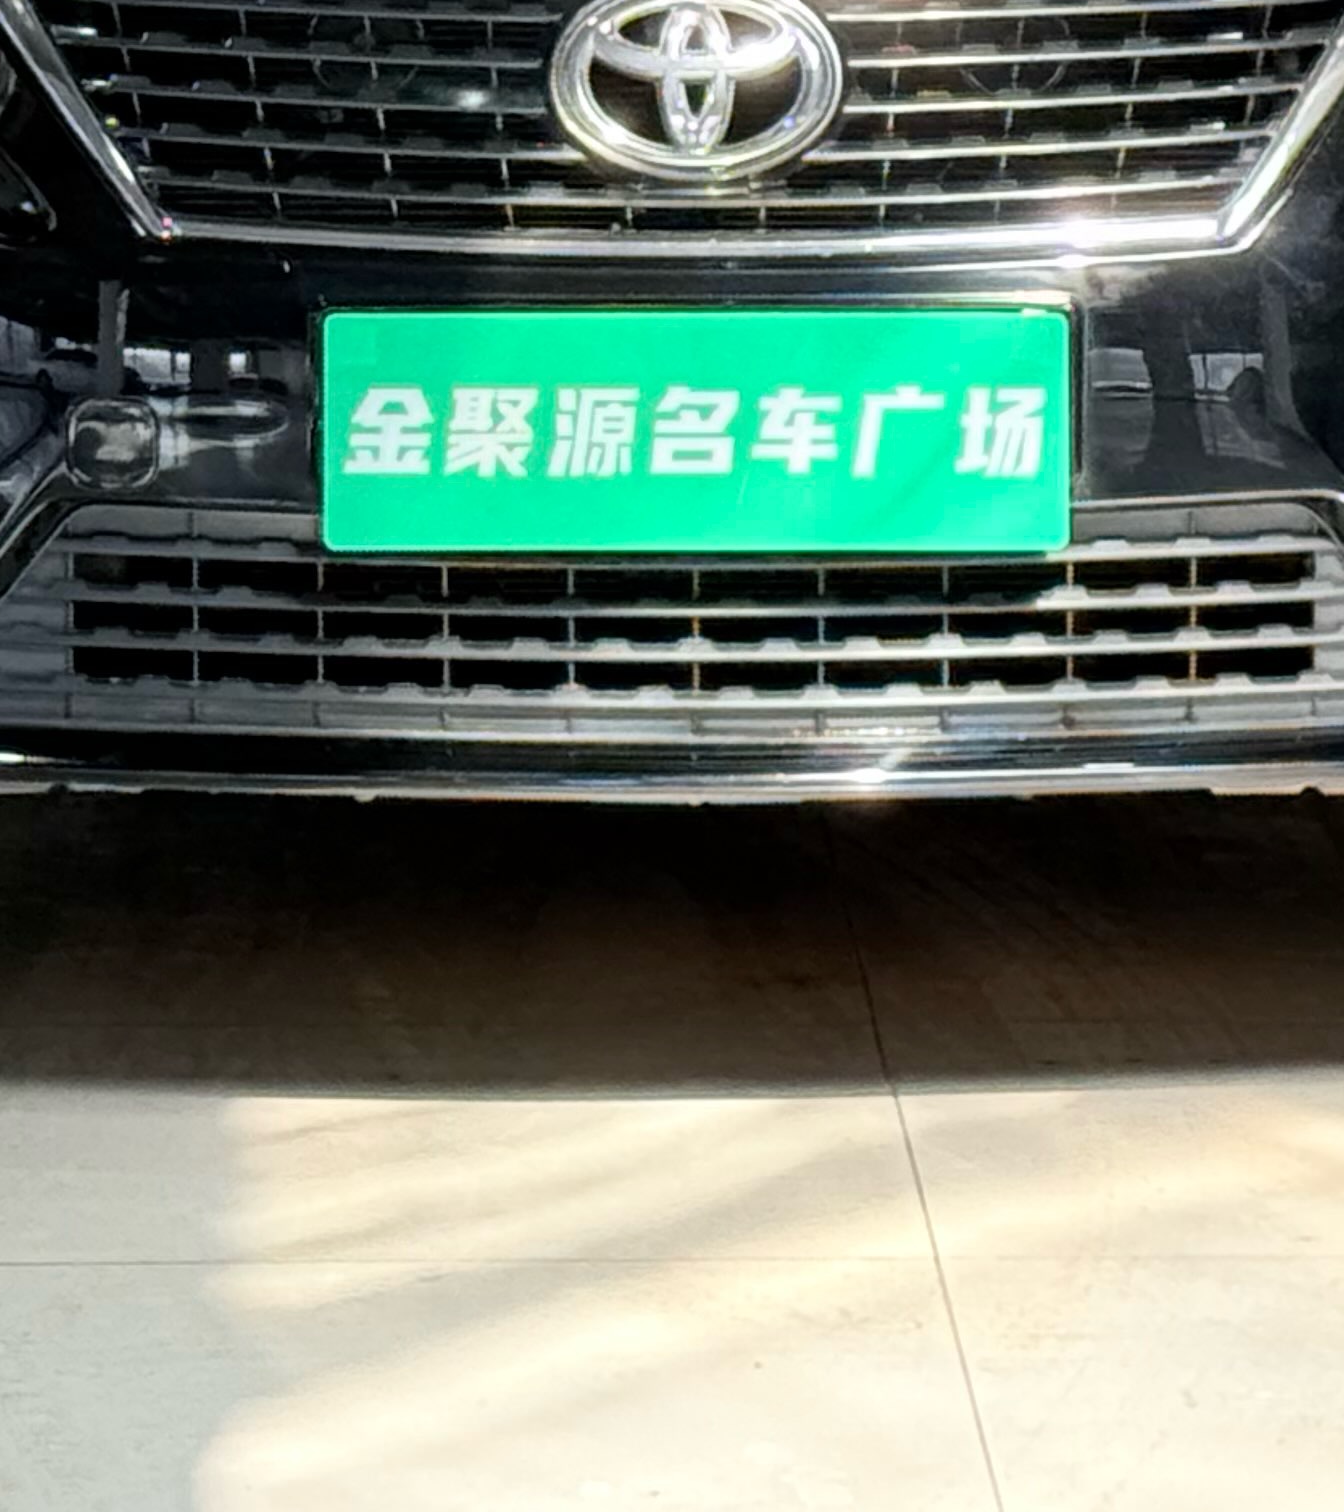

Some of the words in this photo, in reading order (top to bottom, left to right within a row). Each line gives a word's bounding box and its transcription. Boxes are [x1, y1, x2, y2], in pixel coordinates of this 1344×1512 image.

[341, 384, 1049, 480] 金聚源名车广场
